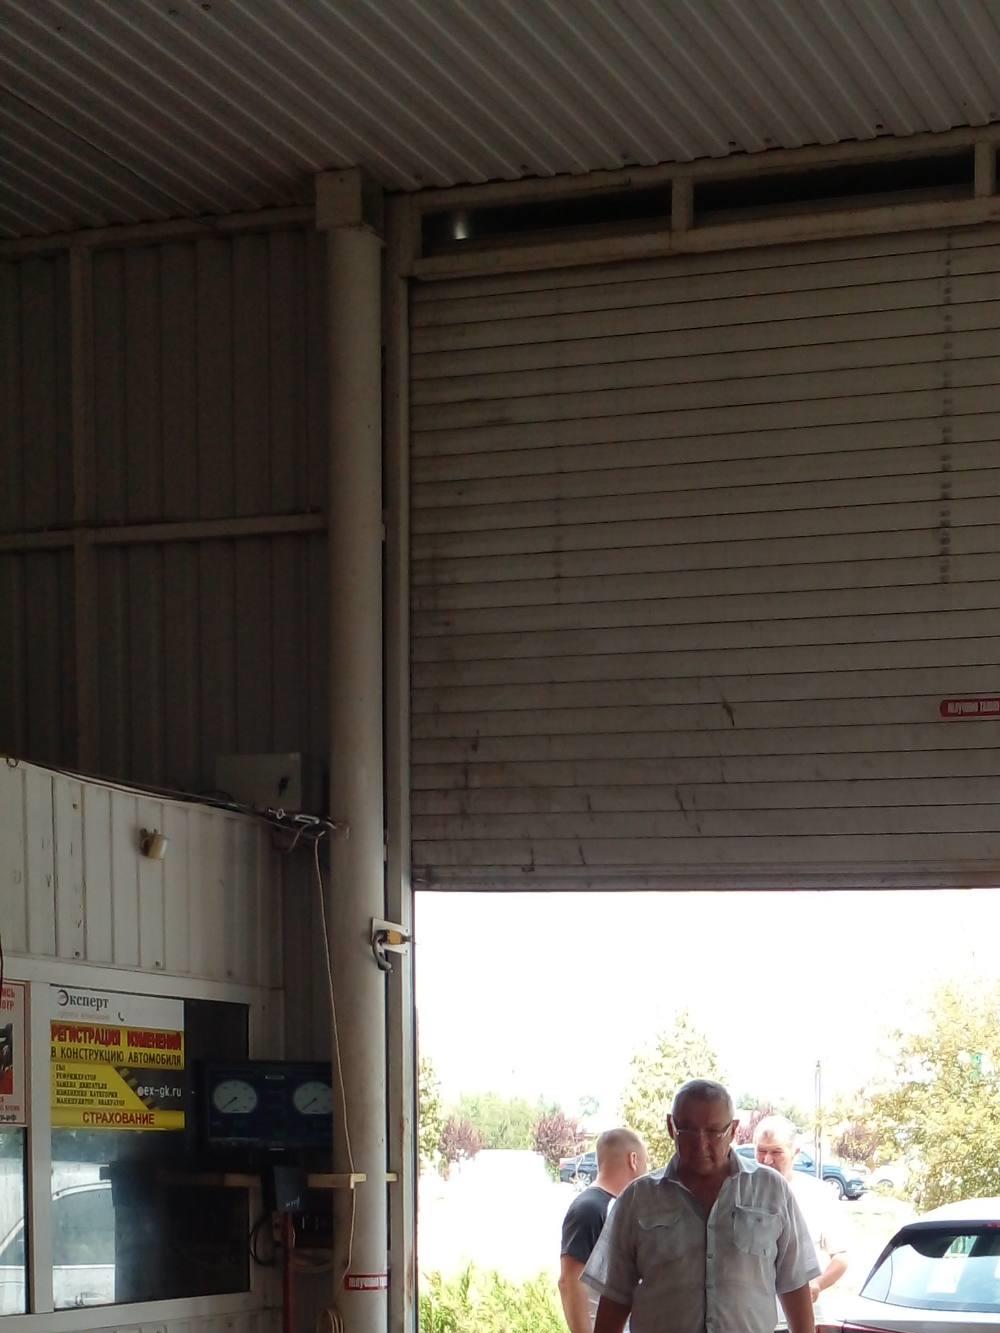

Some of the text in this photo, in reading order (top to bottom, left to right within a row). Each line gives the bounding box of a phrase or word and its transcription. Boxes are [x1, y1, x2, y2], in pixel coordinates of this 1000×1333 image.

[57, 989, 109, 1011] Эксперт
[51, 1046, 181, 1066] В КОНСТРУКЦИЮ АВТОМОБИЛЯ
[82, 1112, 154, 1125] СТРАХОВАНИЕ
